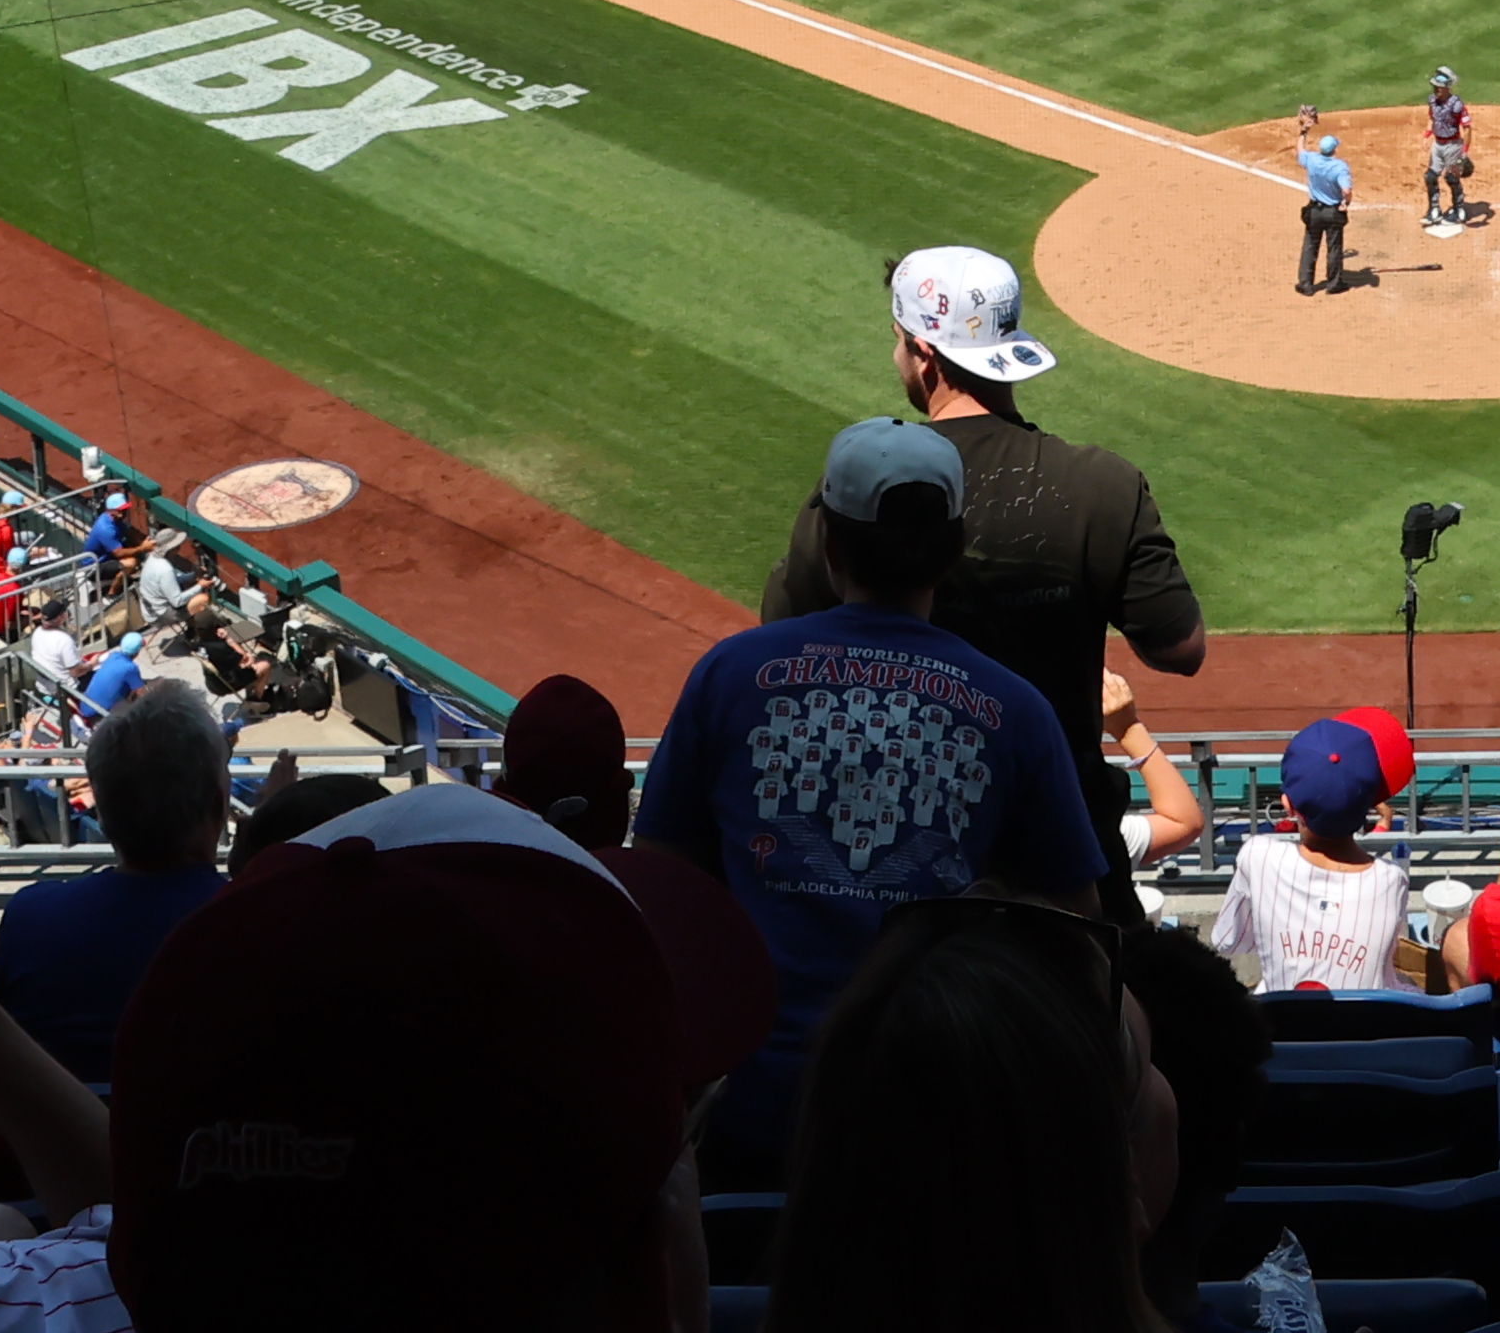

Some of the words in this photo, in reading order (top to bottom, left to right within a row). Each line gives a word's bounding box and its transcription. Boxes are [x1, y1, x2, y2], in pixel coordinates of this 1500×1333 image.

[60, 7, 510, 173] IBX
[846, 645, 910, 665] WORLD
[910, 652, 971, 683] SERIES
[755, 654, 1004, 731] CHAMPIONS
[764, 879, 876, 902] PHILADELPHIA
[1279, 929, 1368, 975] HARPER
